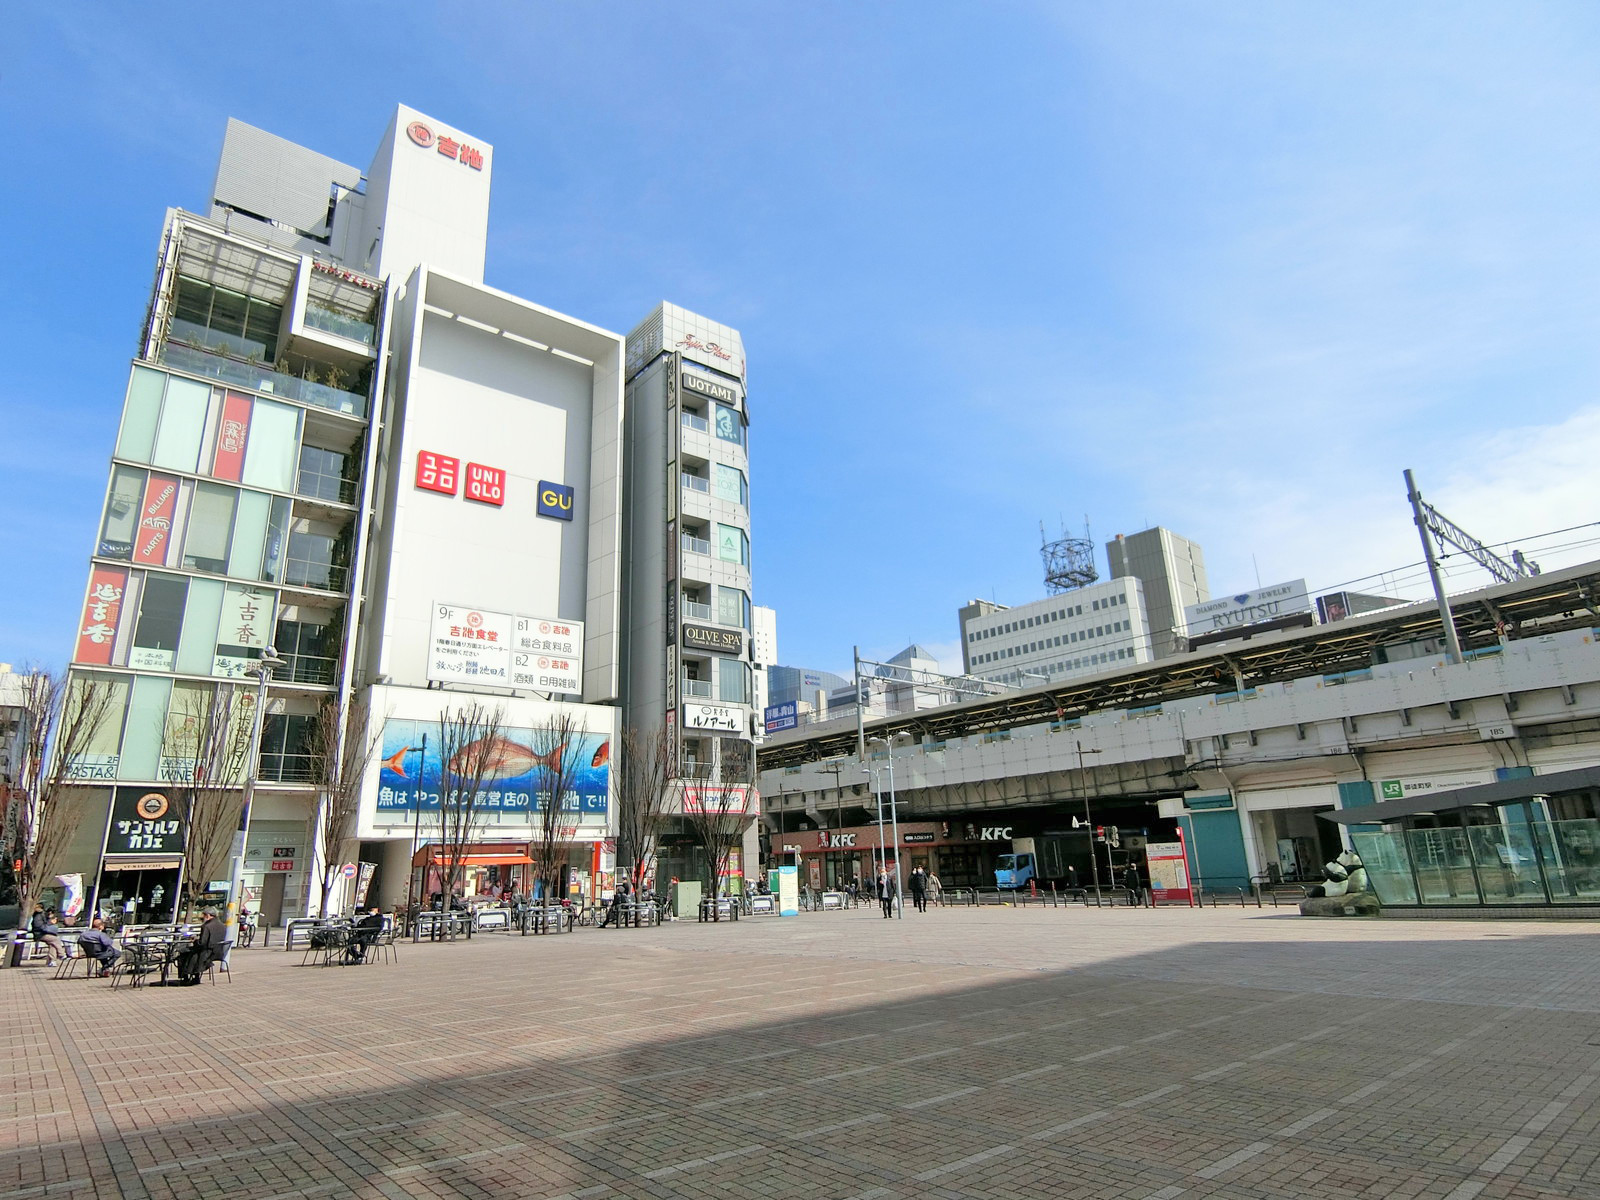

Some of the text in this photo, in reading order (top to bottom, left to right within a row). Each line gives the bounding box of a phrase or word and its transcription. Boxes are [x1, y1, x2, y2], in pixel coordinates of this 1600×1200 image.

[437, 135, 484, 171] 吉池
[688, 376, 732, 401] UOTAMI
[472, 466, 499, 485] UNI
[472, 481, 501, 499] QLO
[148, 484, 175, 515] BILLIARD
[541, 490, 572, 510] GU
[143, 532, 164, 556] DARTS
[1197, 587, 1291, 615] DIAMOND JEWELRY
[439, 606, 454, 620] 9F
[1213, 601, 1278, 627] RYUTSU
[450, 625, 499, 642] 吉池食堂
[518, 619, 571, 636] B1 吉池
[686, 627, 741, 646] OLIVE SPA
[521, 637, 572, 654] 総合食料品
[515, 654, 569, 670] B2 吉池
[513, 672, 577, 689] 酒類 日用雑貨
[693, 715, 737, 730] ルノアール
[106, 756, 118, 764] 2F
[161, 769, 193, 781] WINE
[1384, 783, 1400, 793] JR
[117, 820, 180, 835] サンマルク
[980, 826, 1013, 840] KFC
[129, 834, 164, 849] カフェ
[830, 833, 857, 848] KFC
